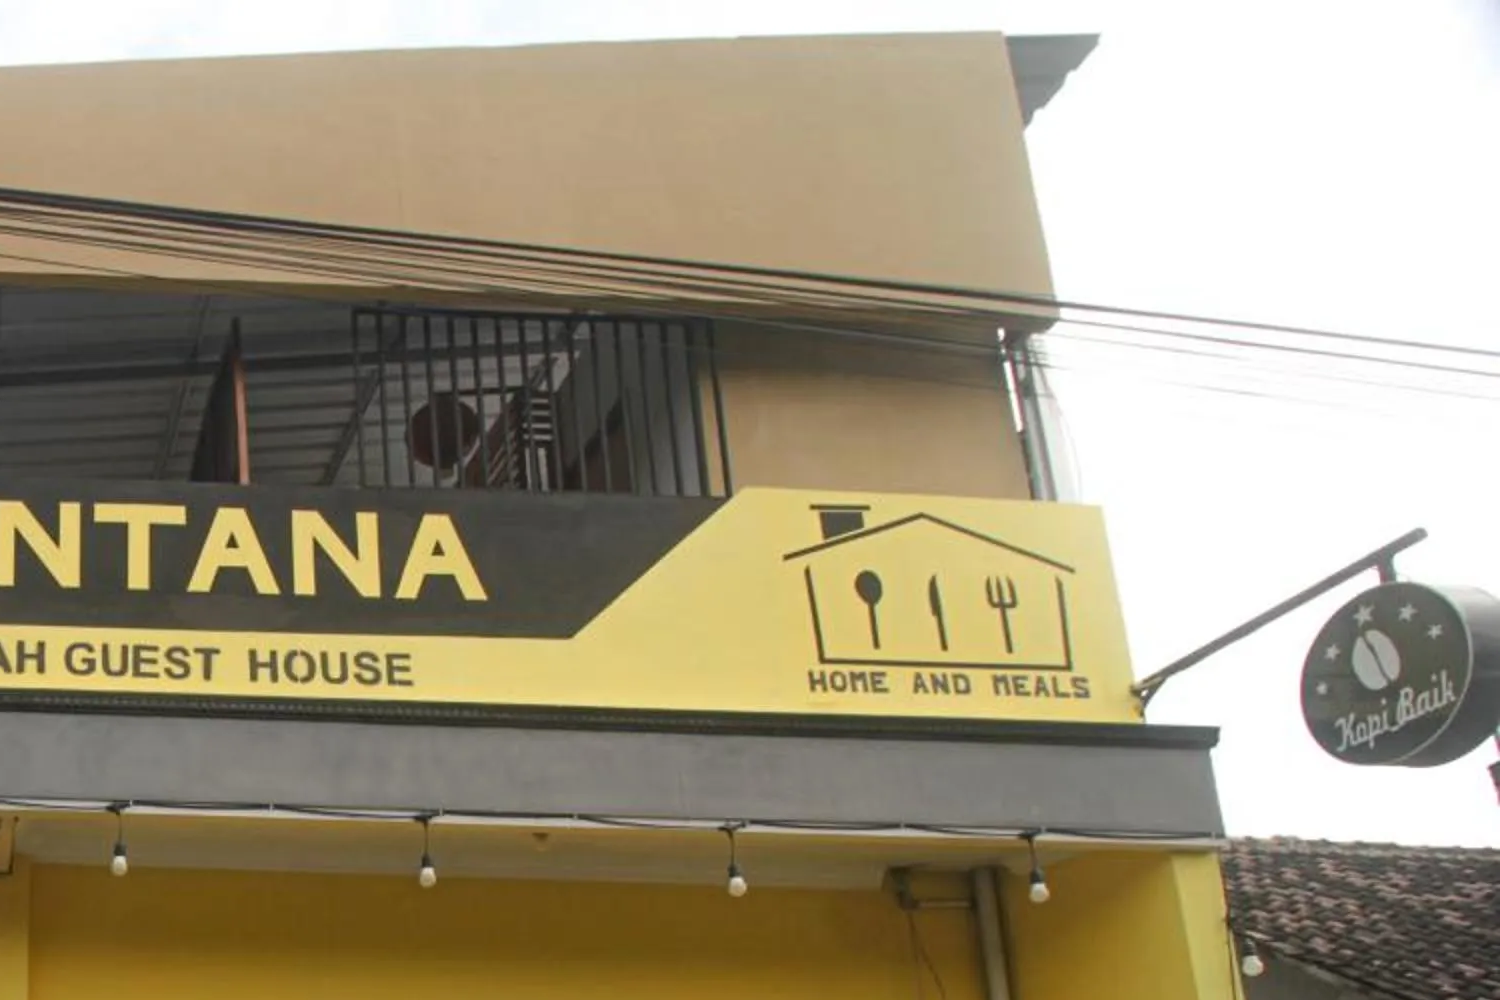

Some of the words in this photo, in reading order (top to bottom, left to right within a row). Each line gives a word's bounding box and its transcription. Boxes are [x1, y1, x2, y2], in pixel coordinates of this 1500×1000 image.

[63, 641, 221, 683] GUEST
[248, 648, 414, 687] HOUSE
[808, 669, 891, 694] HOME
[912, 672, 972, 696] AND
[991, 674, 1092, 699] MEALS
[1334, 698, 1391, 753] Kopi
[1391, 668, 1457, 731] Baik
